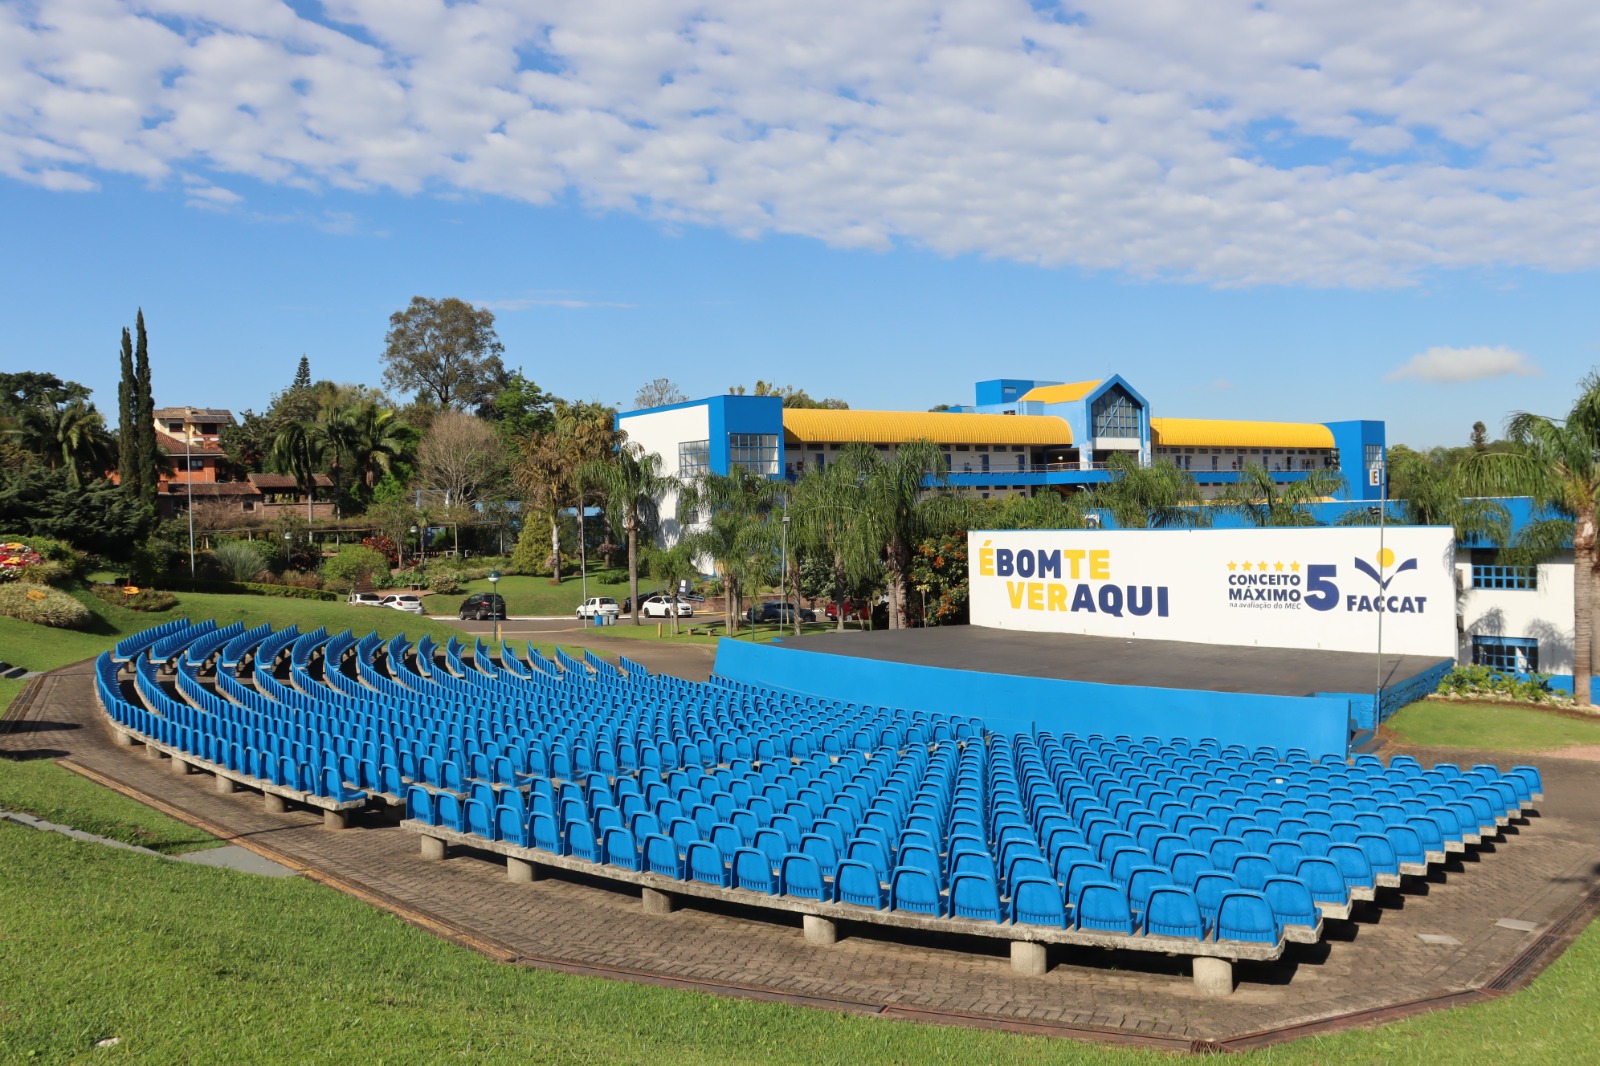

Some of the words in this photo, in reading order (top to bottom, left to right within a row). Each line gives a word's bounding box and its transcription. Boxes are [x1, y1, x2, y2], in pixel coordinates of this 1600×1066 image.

[1371, 470, 1378, 484] E
[979, 540, 995, 576] É
[996, 548, 1062, 579] BOM
[1064, 549, 1110, 580] TE
[1228, 574, 1301, 586] CONCEITO
[1303, 564, 1340, 612] 5
[1006, 581, 1067, 612] VER
[1071, 583, 1169, 618] AQUI
[1228, 586, 1301, 602] MÁXIMO
[1284, 602, 1302, 610] MEC
[1346, 594, 1427, 613] FACCAT
